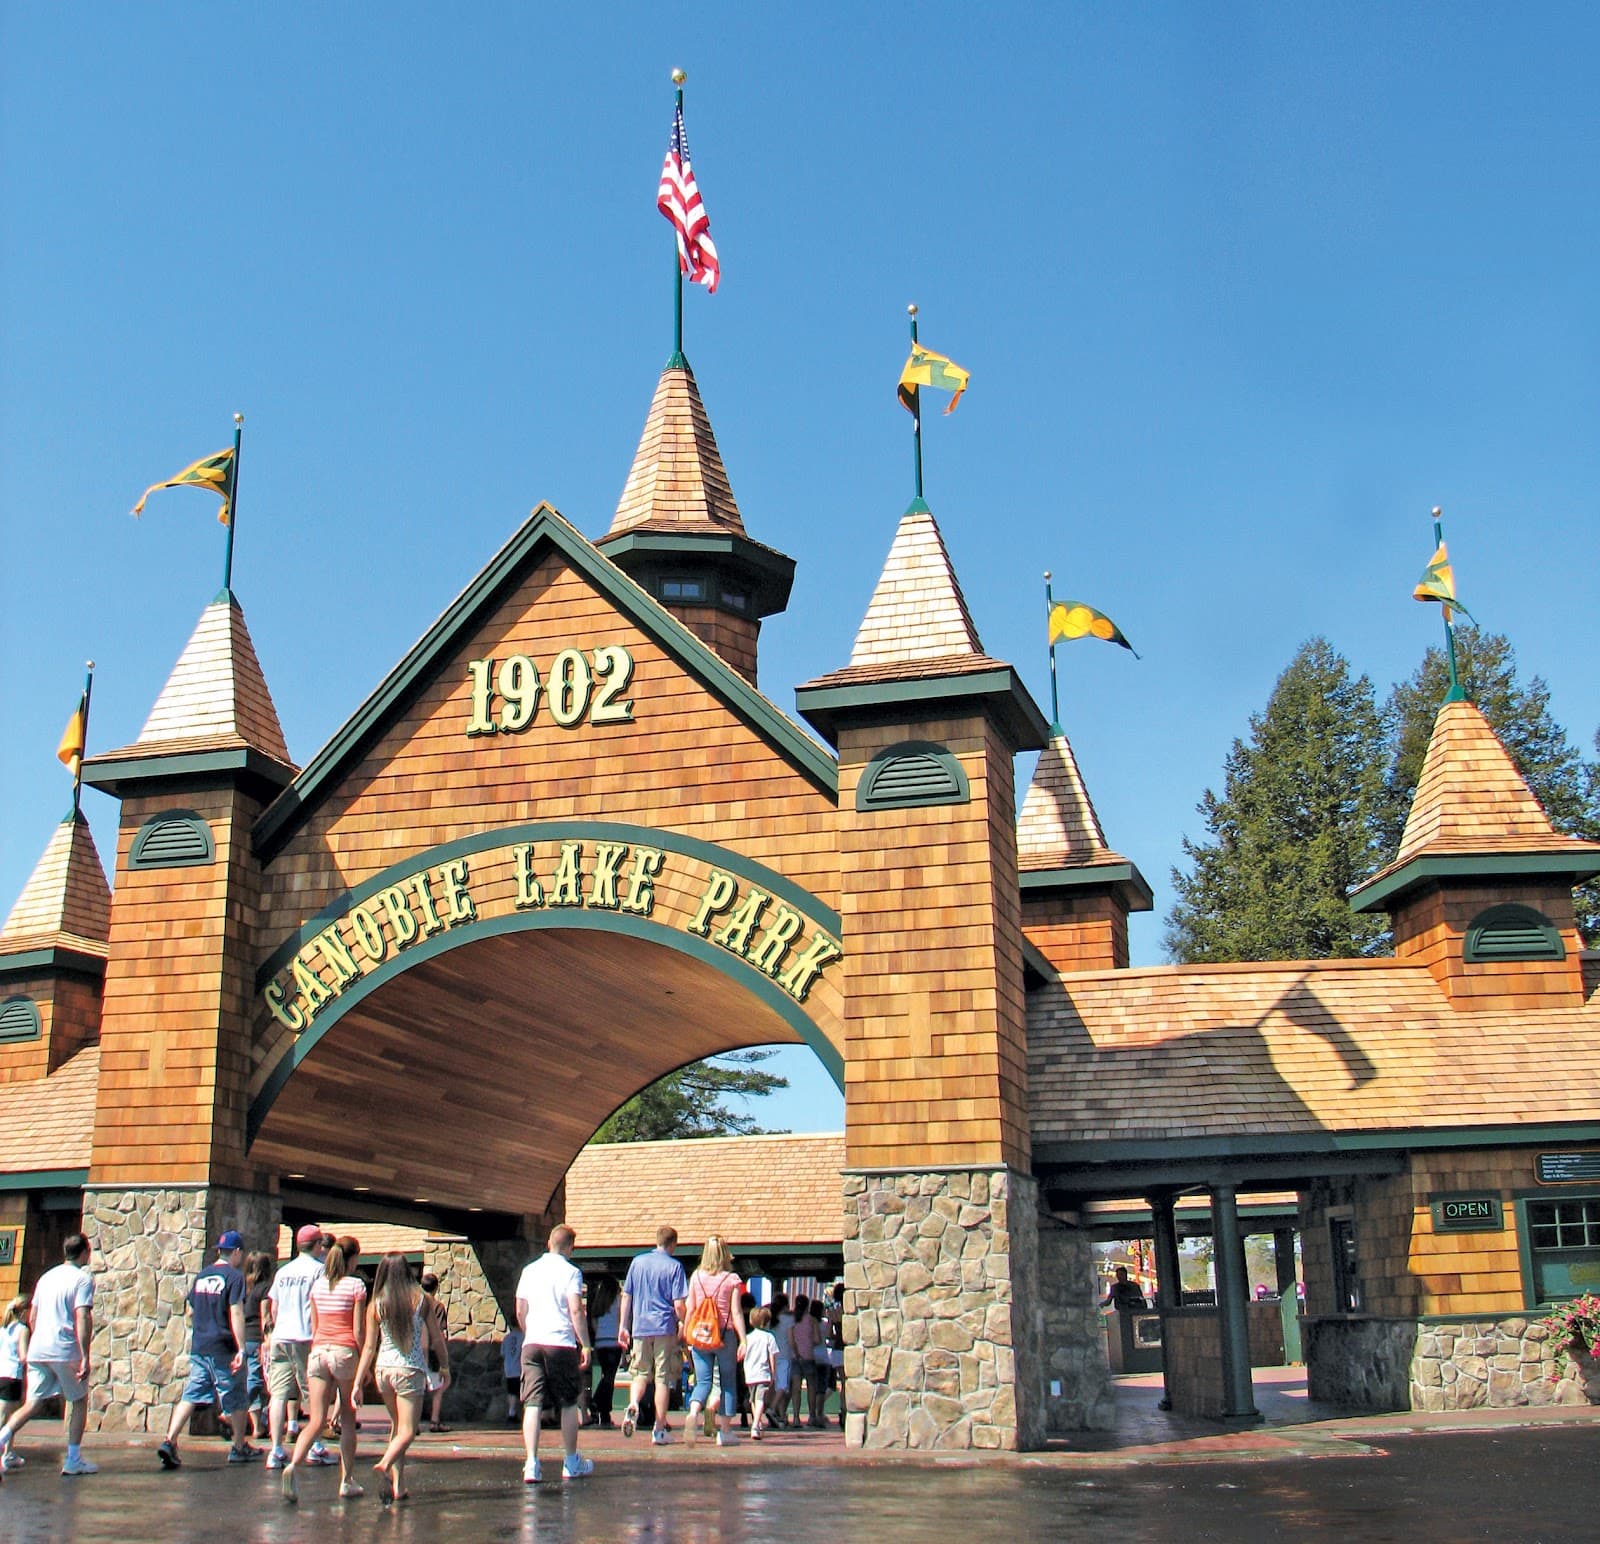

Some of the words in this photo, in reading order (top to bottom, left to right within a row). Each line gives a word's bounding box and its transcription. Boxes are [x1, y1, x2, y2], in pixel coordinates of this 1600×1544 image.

[466, 645, 636, 737] 1902
[264, 859, 479, 1033] CANOBIE
[513, 842, 665, 916] LAKE
[687, 871, 842, 1003] PARK
[1446, 1202, 1489, 1217] OPEN
